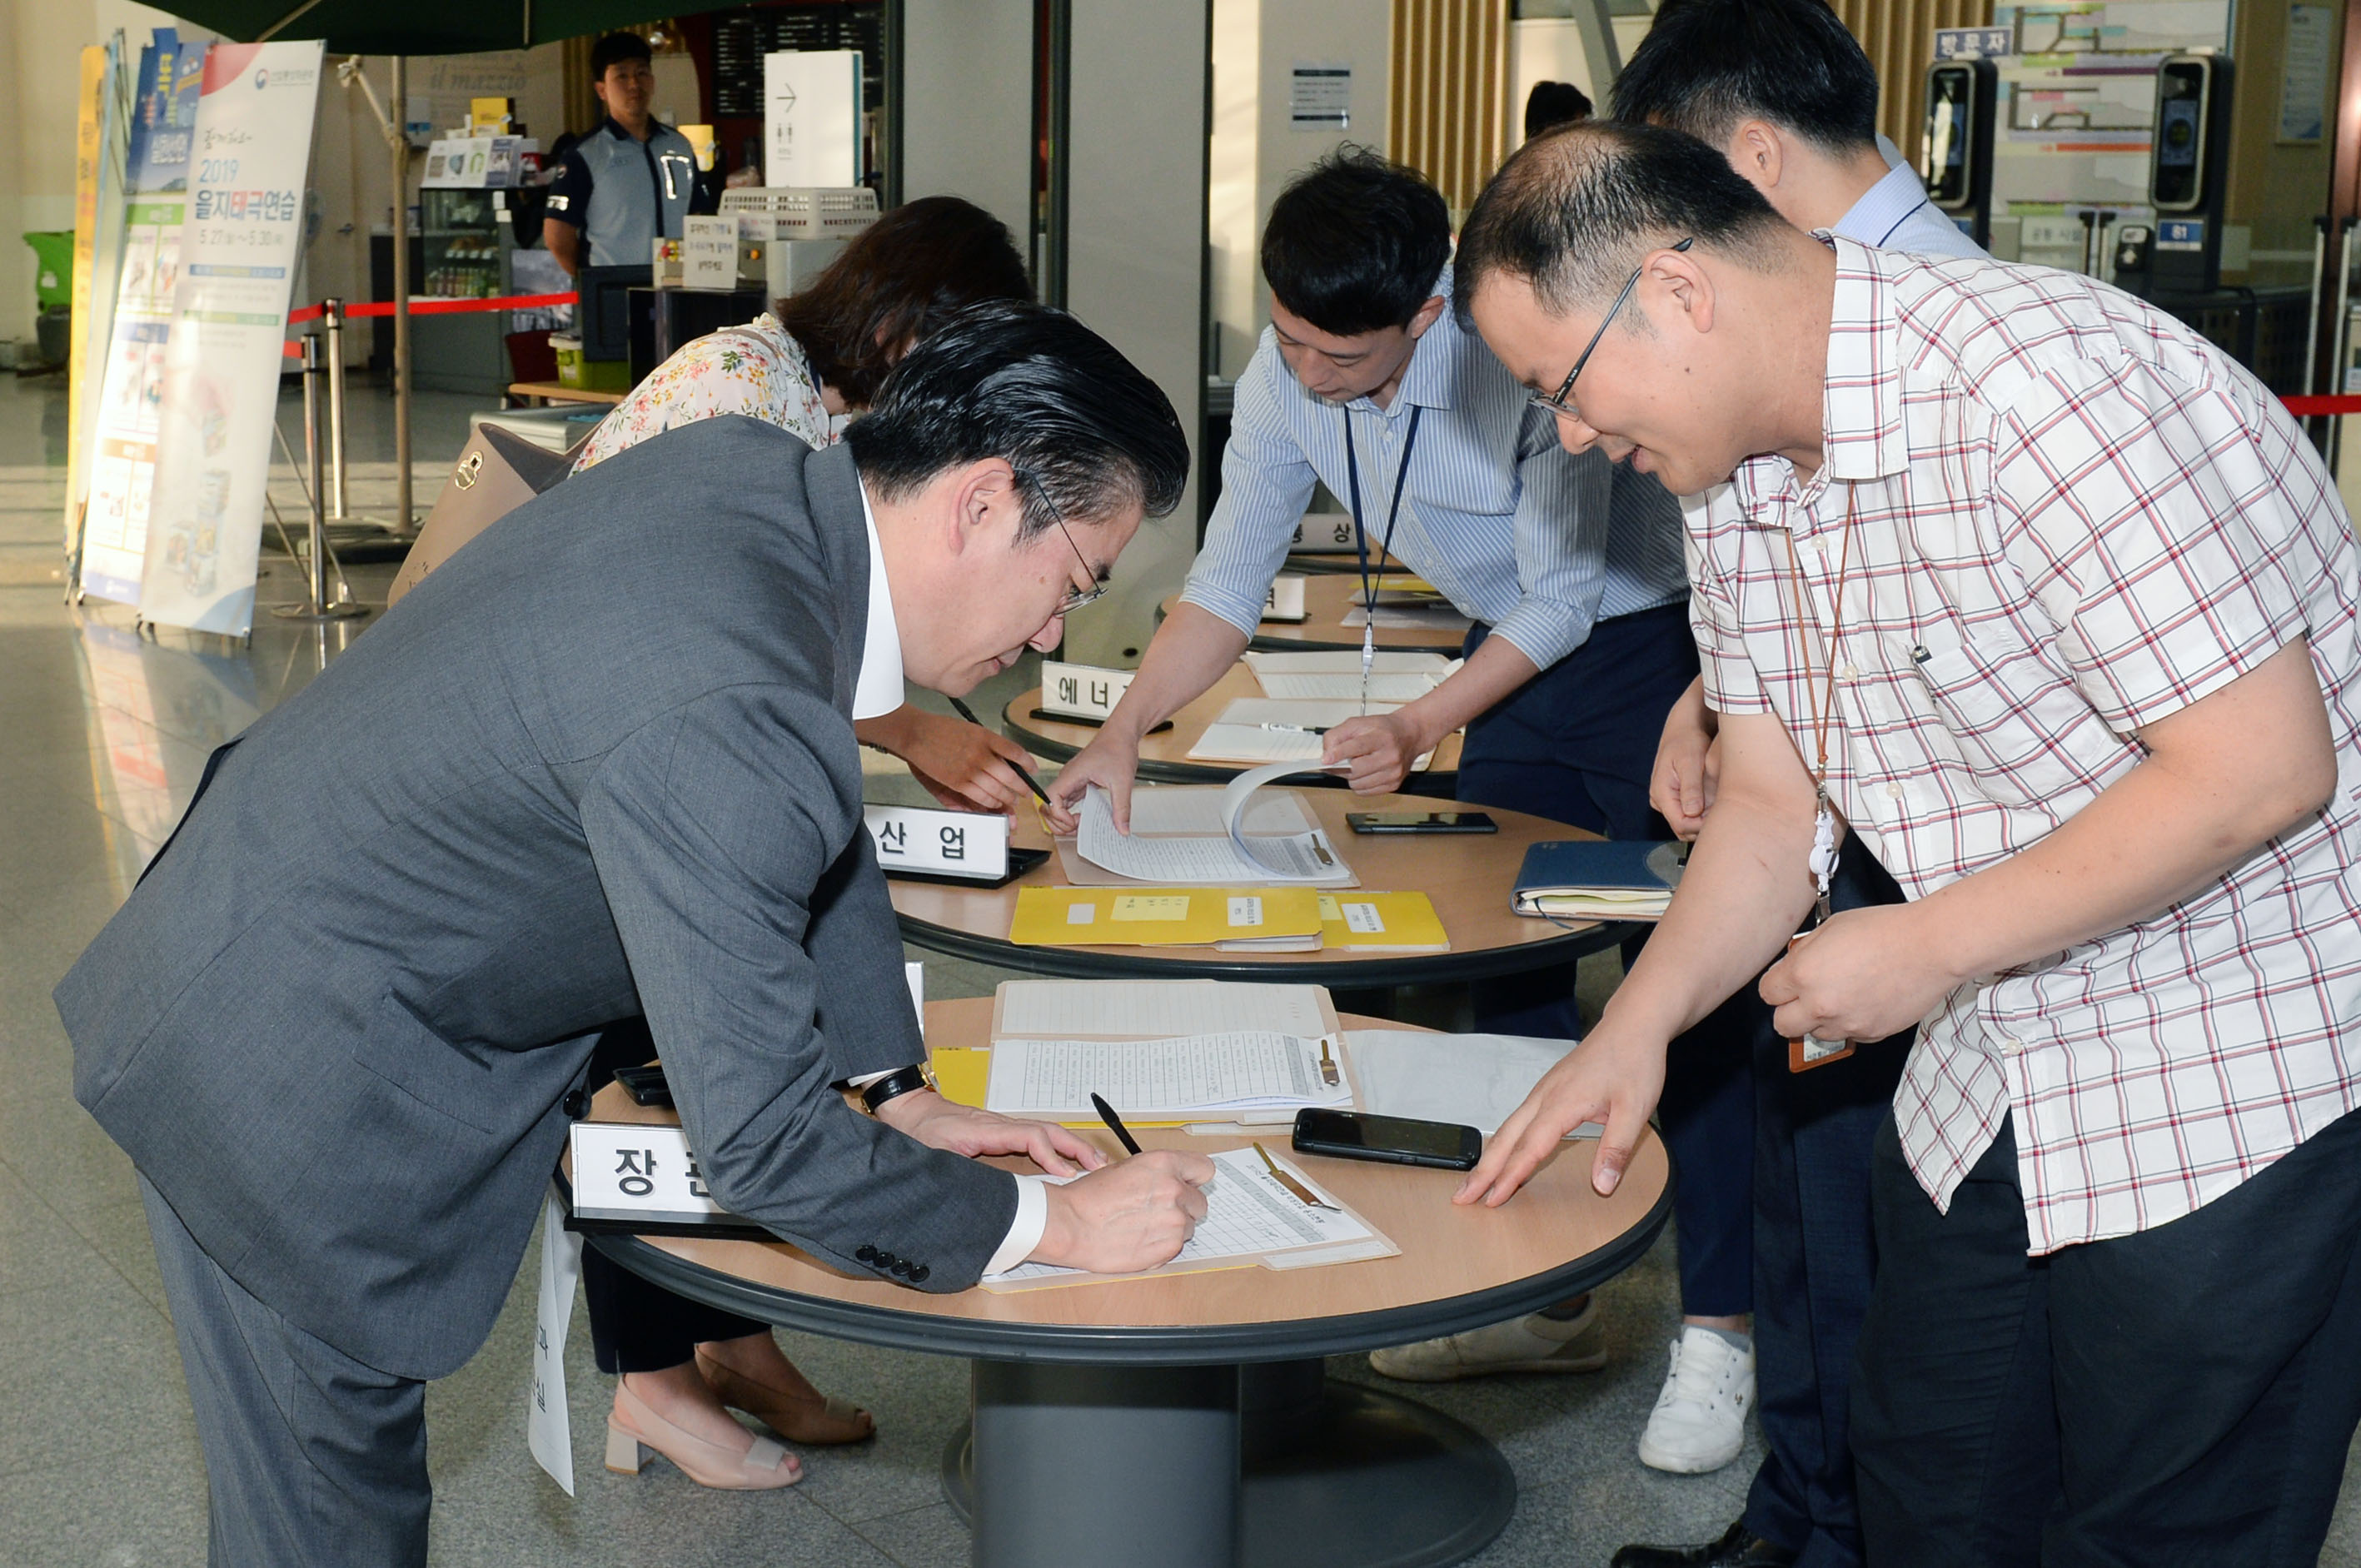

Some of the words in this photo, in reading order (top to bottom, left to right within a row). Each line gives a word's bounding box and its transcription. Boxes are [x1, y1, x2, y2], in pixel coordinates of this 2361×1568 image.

[1940, 32, 2005, 56] 방문자
[198, 159, 240, 182] 2019
[196, 190, 295, 221] 을지태극연습
[879, 820, 964, 859] 산업
